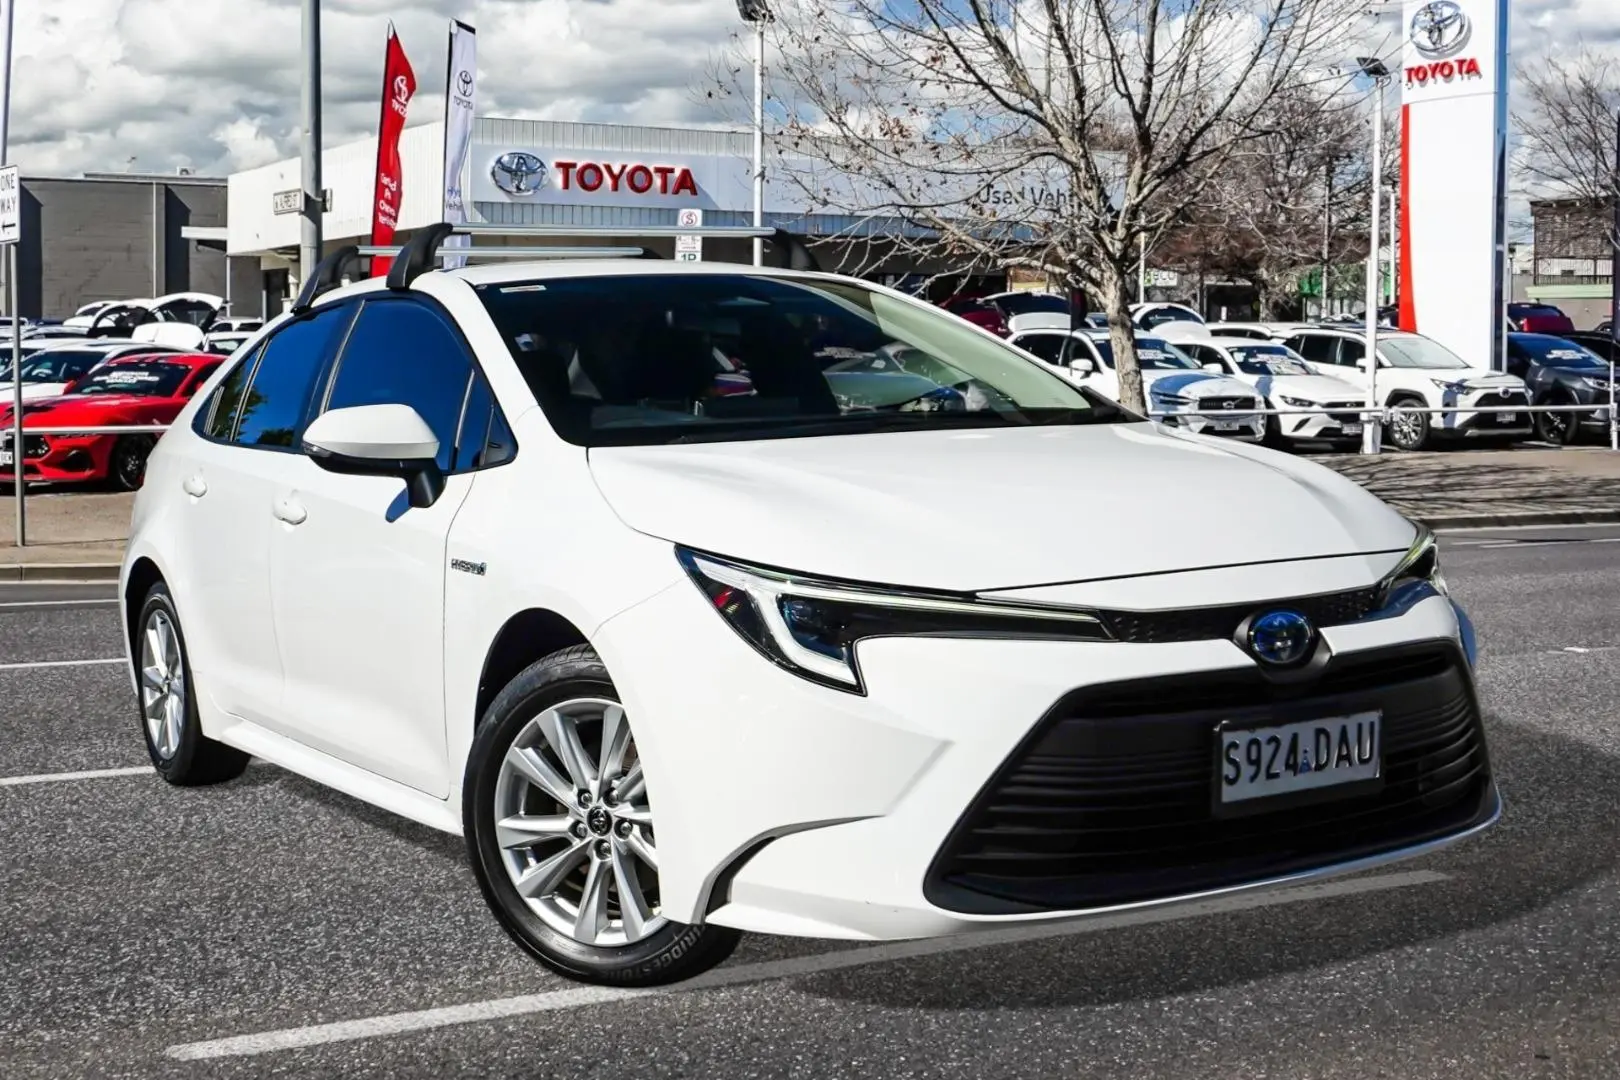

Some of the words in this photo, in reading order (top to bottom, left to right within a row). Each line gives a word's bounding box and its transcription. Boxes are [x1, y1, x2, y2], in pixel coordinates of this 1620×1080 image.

[1404, 58, 1481, 83] TOYOTA
[555, 161, 698, 196] TOYOTA
[1313, 720, 1376, 773] DAU
